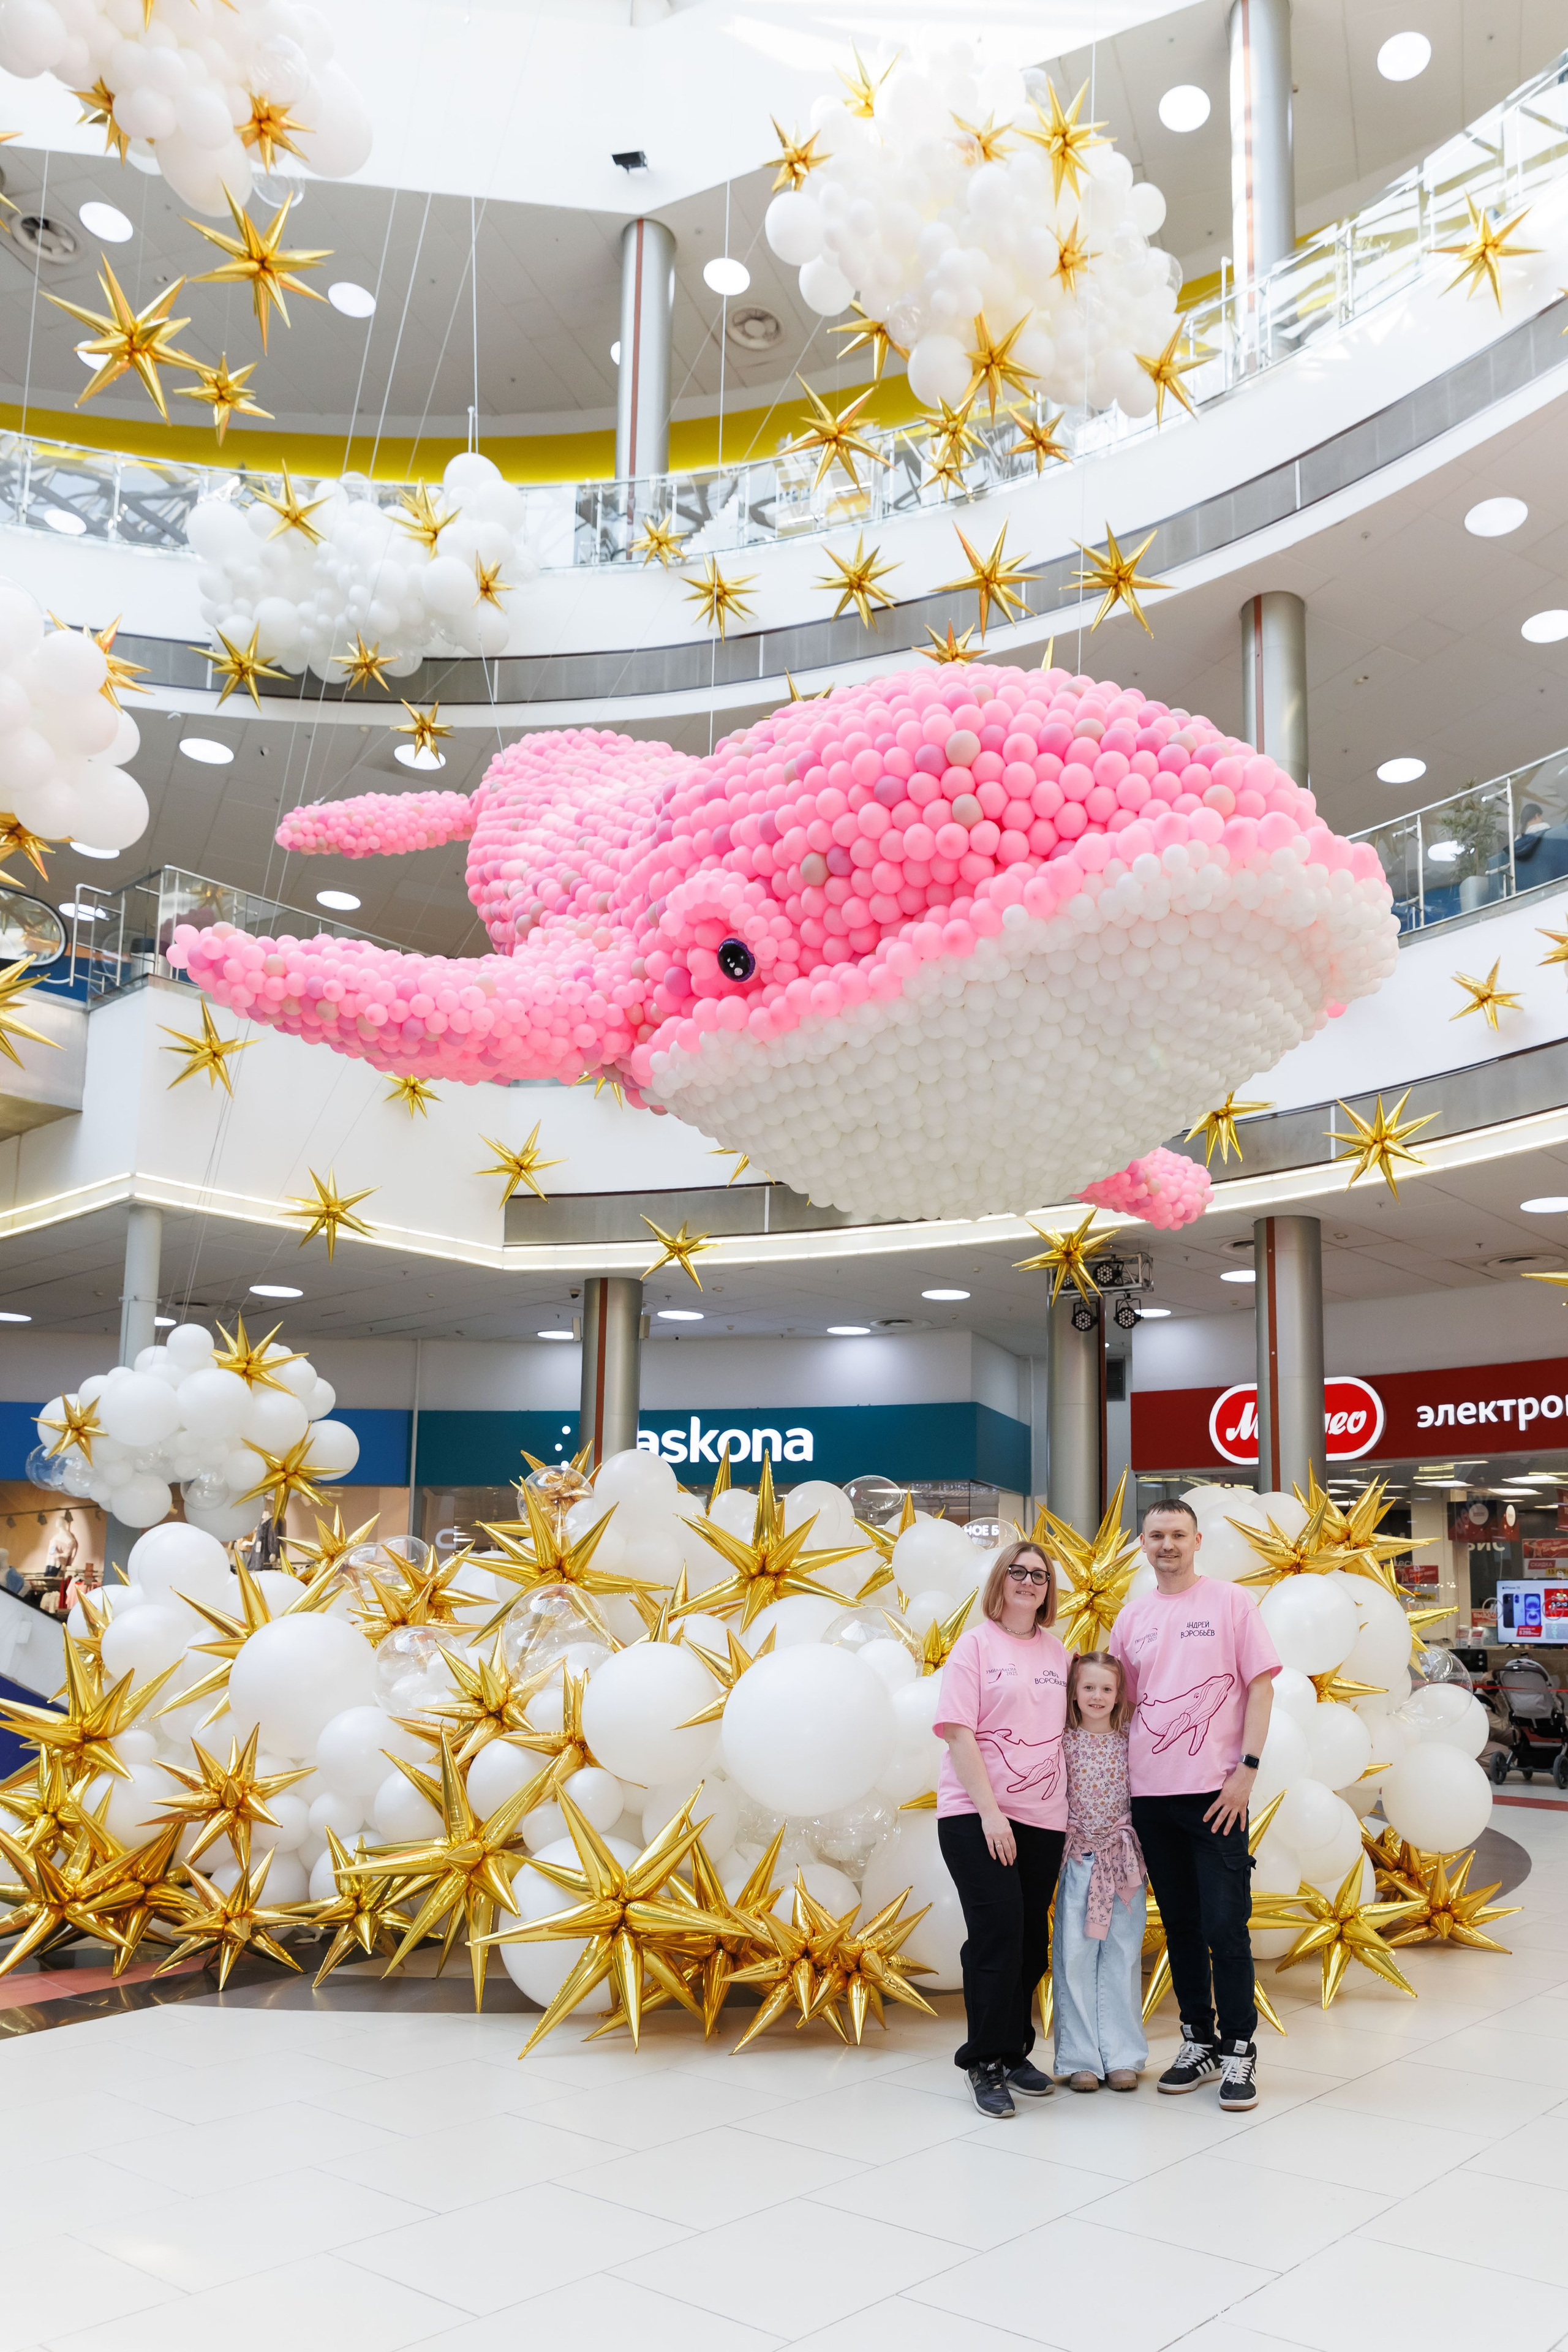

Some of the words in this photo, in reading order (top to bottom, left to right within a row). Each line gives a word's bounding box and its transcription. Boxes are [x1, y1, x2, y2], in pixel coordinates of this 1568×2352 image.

[1416, 1395, 1568, 1431] электро
[638, 1416, 813, 1463] askona
[1180, 1629, 1215, 1639] ВОРОБЬЁВ
[1186, 1620, 1210, 1629] АНДРЕЙ
